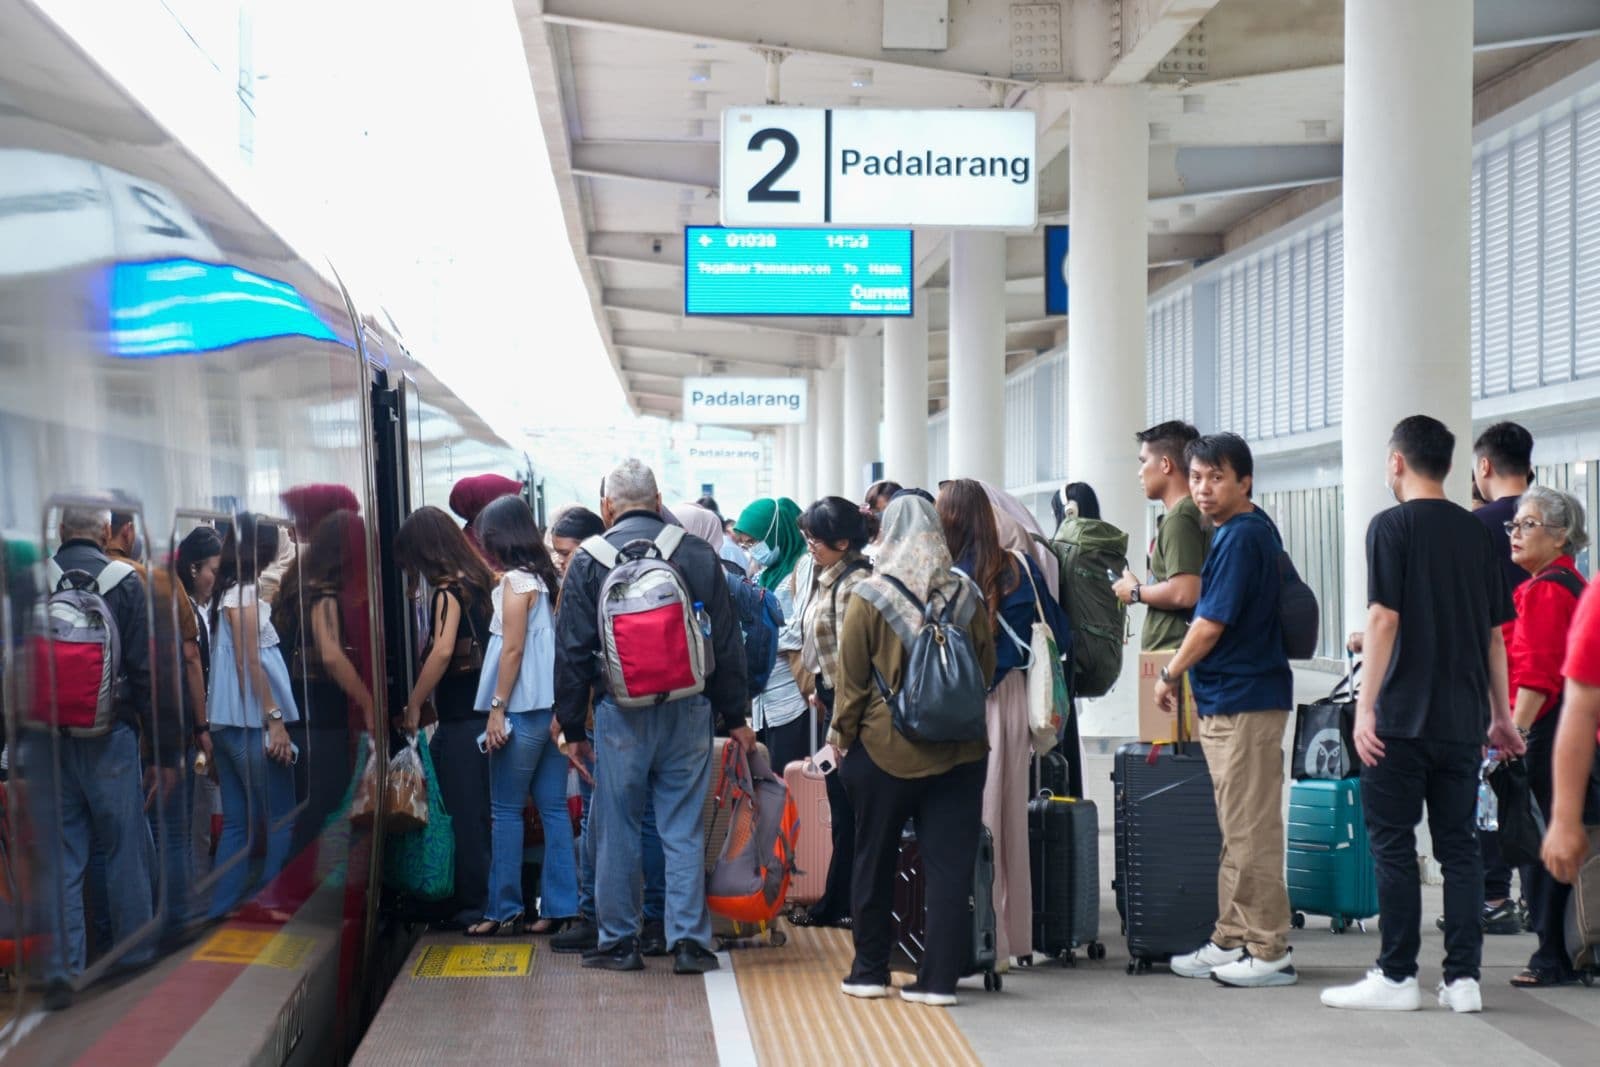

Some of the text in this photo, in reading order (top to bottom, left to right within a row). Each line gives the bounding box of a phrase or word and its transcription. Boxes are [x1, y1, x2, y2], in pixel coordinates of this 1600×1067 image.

[747, 127, 801, 203] 2
[841, 149, 1030, 184] Padalarang
[692, 391, 800, 410] Padalarang
